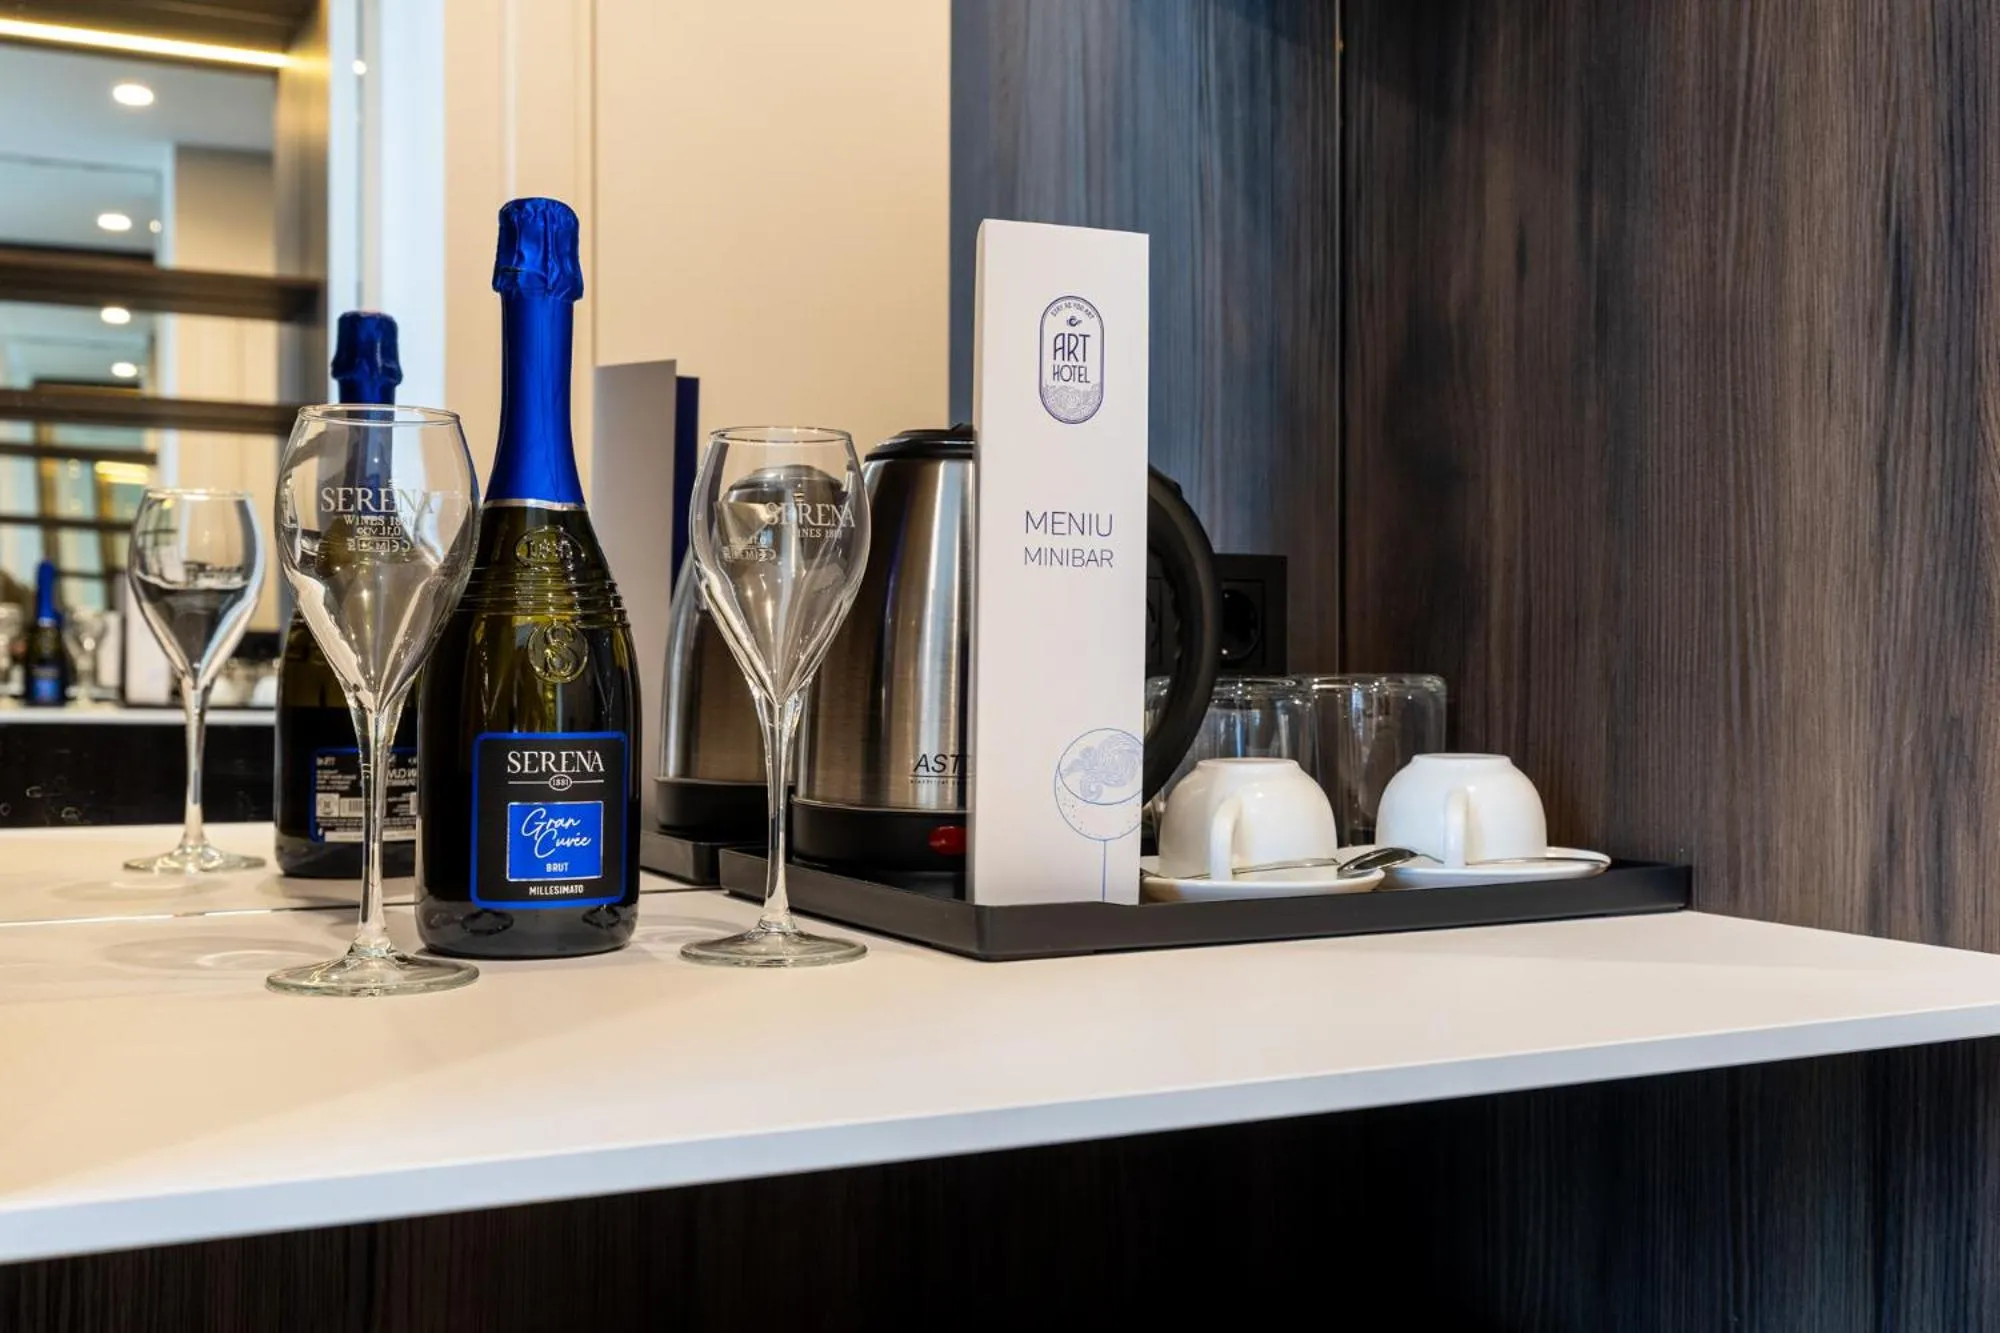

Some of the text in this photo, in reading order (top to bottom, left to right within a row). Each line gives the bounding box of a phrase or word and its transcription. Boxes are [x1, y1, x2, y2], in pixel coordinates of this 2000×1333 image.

[1053, 332, 1091, 363] ART
[1052, 364, 1091, 384] HOTEL
[320, 486, 436, 514] SERENA
[343, 514, 386, 526] WINES
[765, 501, 855, 528] SERENA
[1025, 509, 1113, 537] MENIU
[1024, 546, 1114, 568] MINIBAR
[507, 750, 605, 774] SERENA
[521, 807, 581, 841] Gran
[534, 828, 592, 859] Cuvée
[546, 862, 569, 873] BRUT
[529, 884, 584, 896] MILLESIMATO
